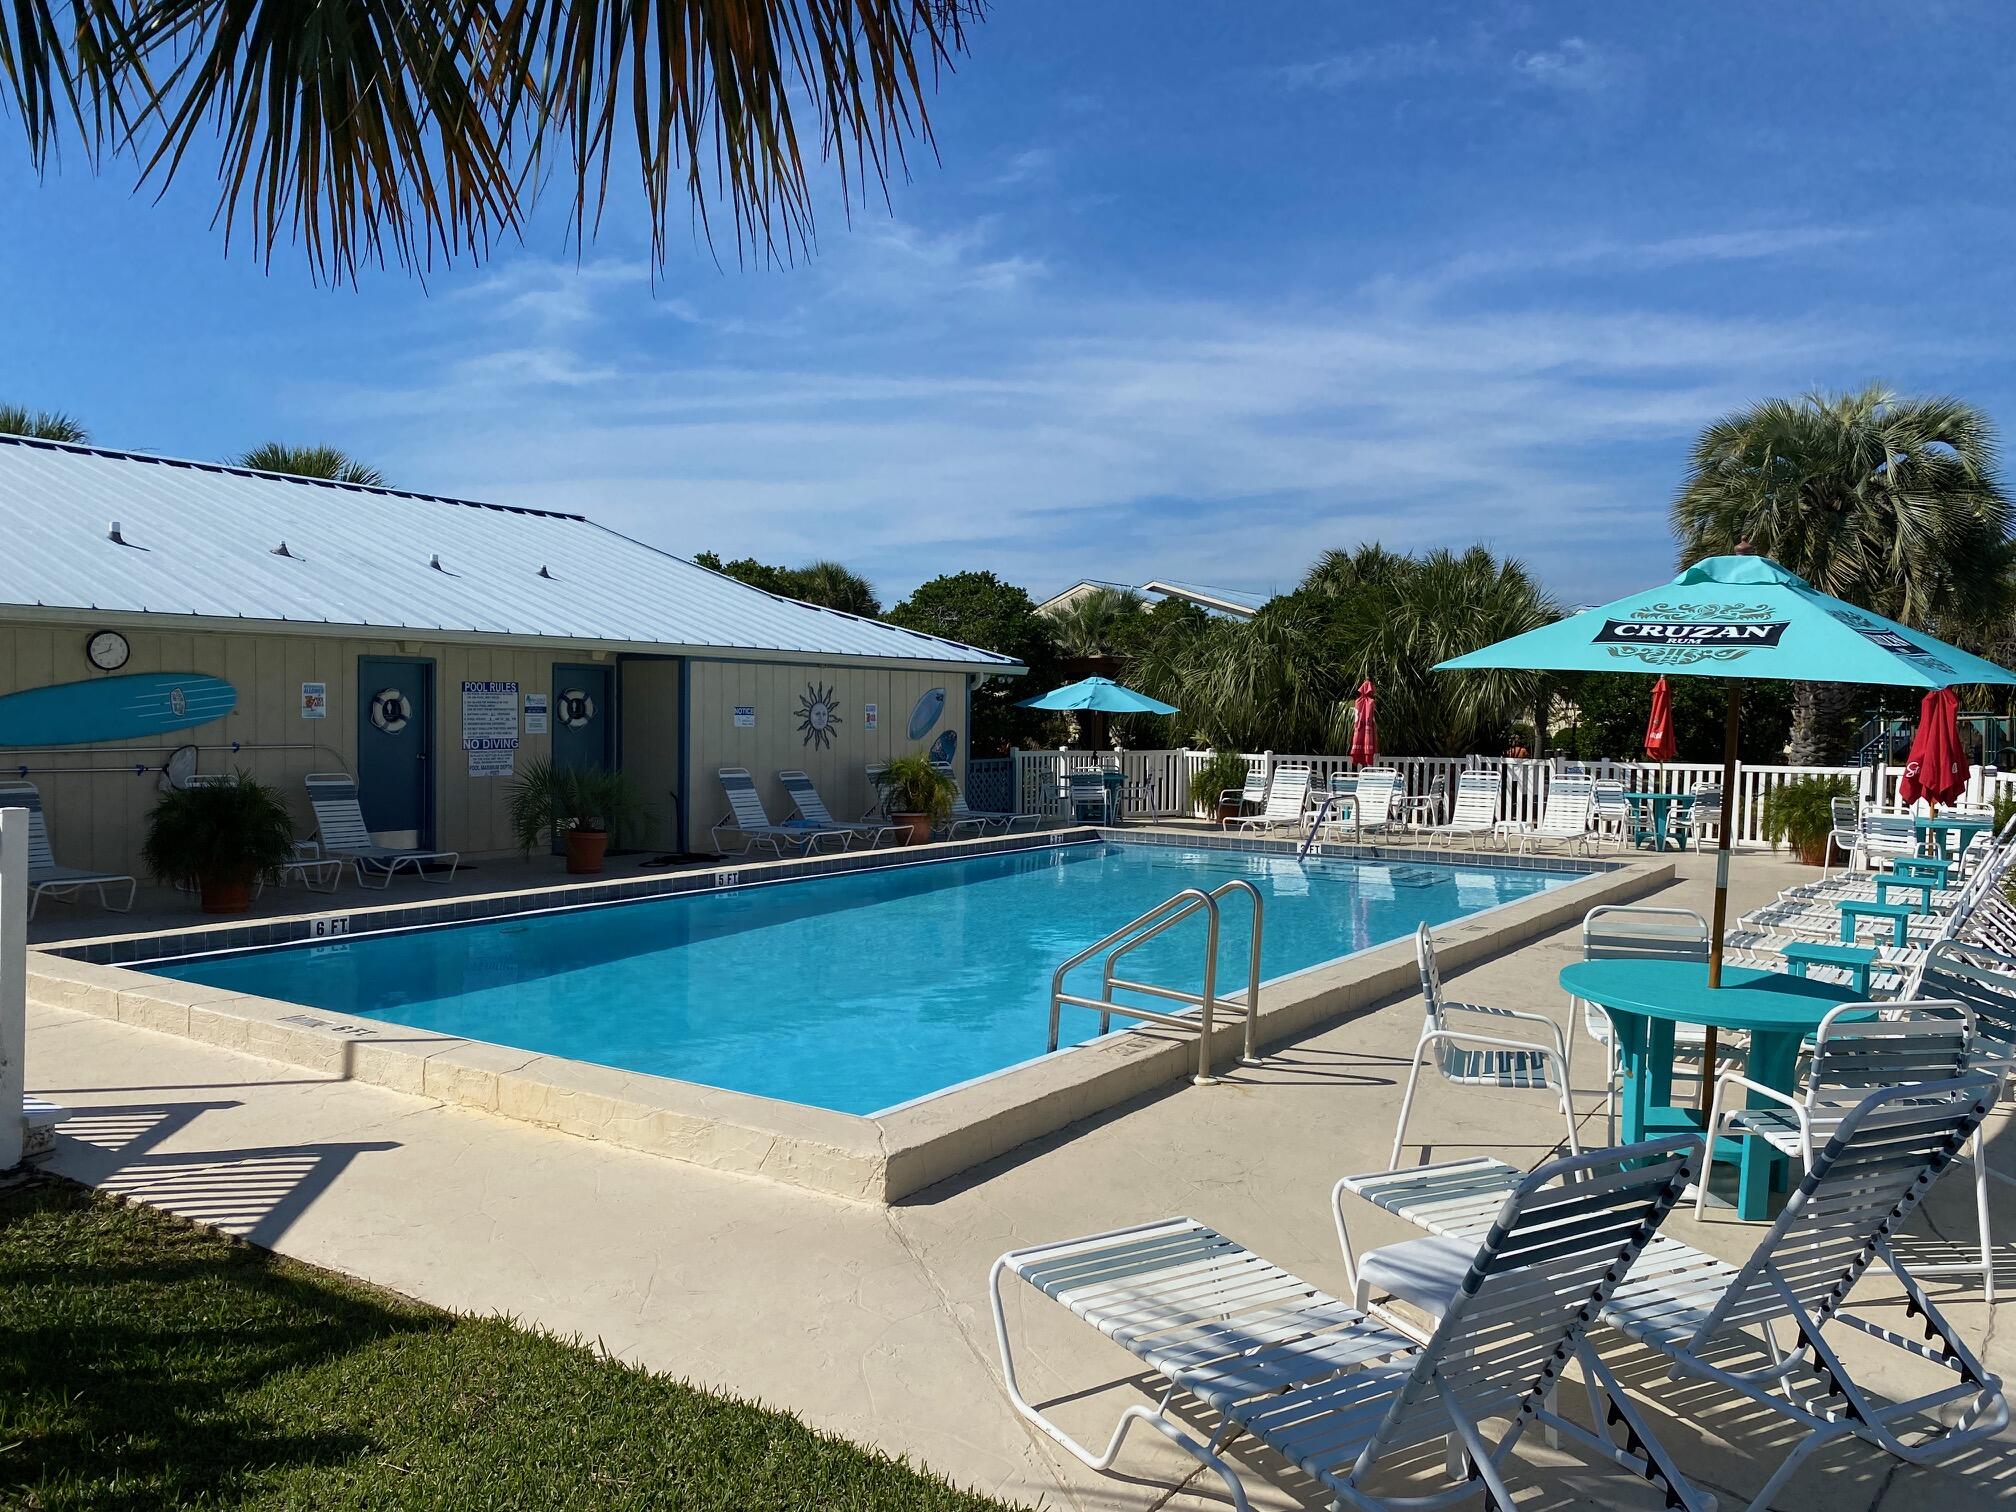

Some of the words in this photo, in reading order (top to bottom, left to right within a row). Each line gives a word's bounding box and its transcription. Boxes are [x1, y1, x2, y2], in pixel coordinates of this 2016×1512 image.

[1613, 624, 1773, 638] CRUZAN
[465, 682, 488, 692] POOL
[490, 682, 517, 692] RULES
[735, 707, 754, 715] NOTICE
[463, 739, 480, 749] NO
[482, 738, 519, 749] DIVING
[1310, 845, 1320, 854] FT
[719, 875, 724, 886] 5
[316, 921, 325, 936] 6
[344, 1028, 378, 1036] FT
